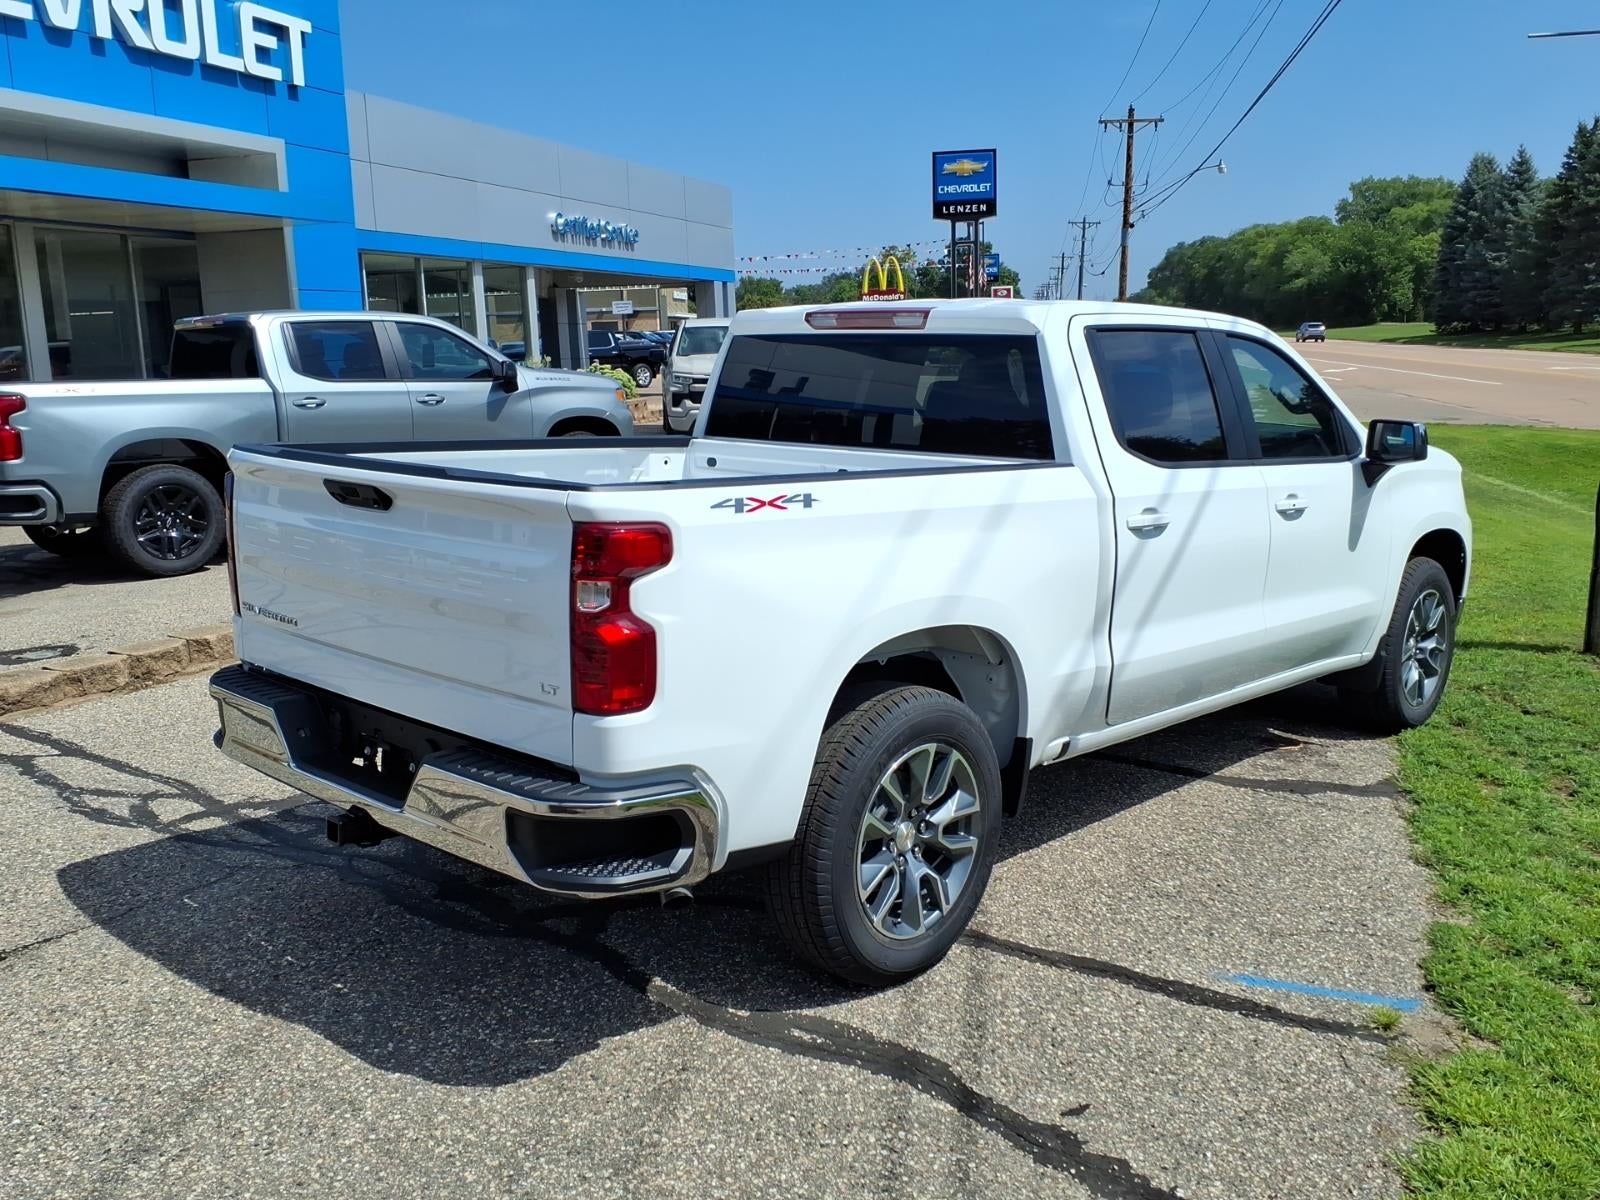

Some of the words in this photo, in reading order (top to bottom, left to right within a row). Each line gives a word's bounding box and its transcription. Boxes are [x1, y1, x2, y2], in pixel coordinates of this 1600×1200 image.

[938, 183, 991, 194] CHEVROLET
[943, 204, 987, 214] LENZEN
[862, 294, 904, 302] McDonald's
[540, 682, 560, 696] LT
